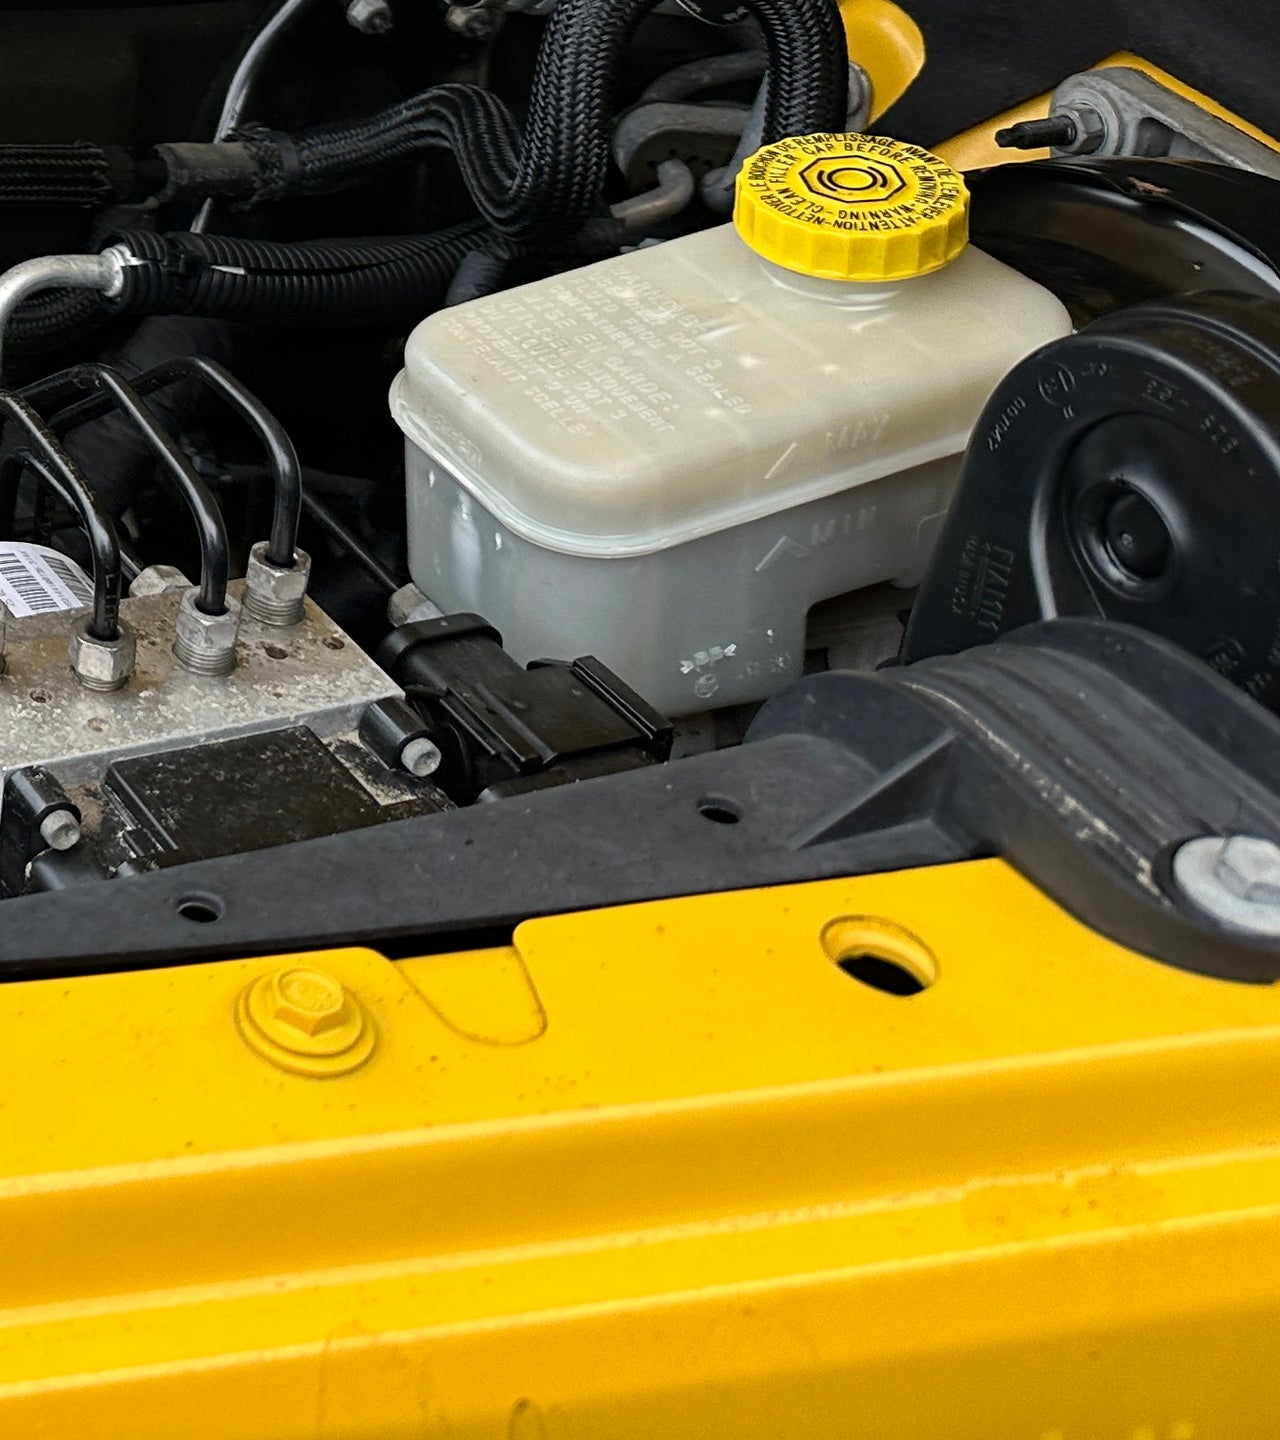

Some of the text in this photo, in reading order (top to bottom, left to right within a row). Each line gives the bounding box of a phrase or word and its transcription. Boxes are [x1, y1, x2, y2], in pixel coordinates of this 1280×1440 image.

[793, 133, 896, 150] REMPLISSAGE
[803, 142, 835, 156] CAP
[844, 142, 911, 165] BEFORE
[768, 154, 799, 185] FILLER
[778, 186, 824, 214] CLEAN
[839, 202, 916, 220] WARNING
